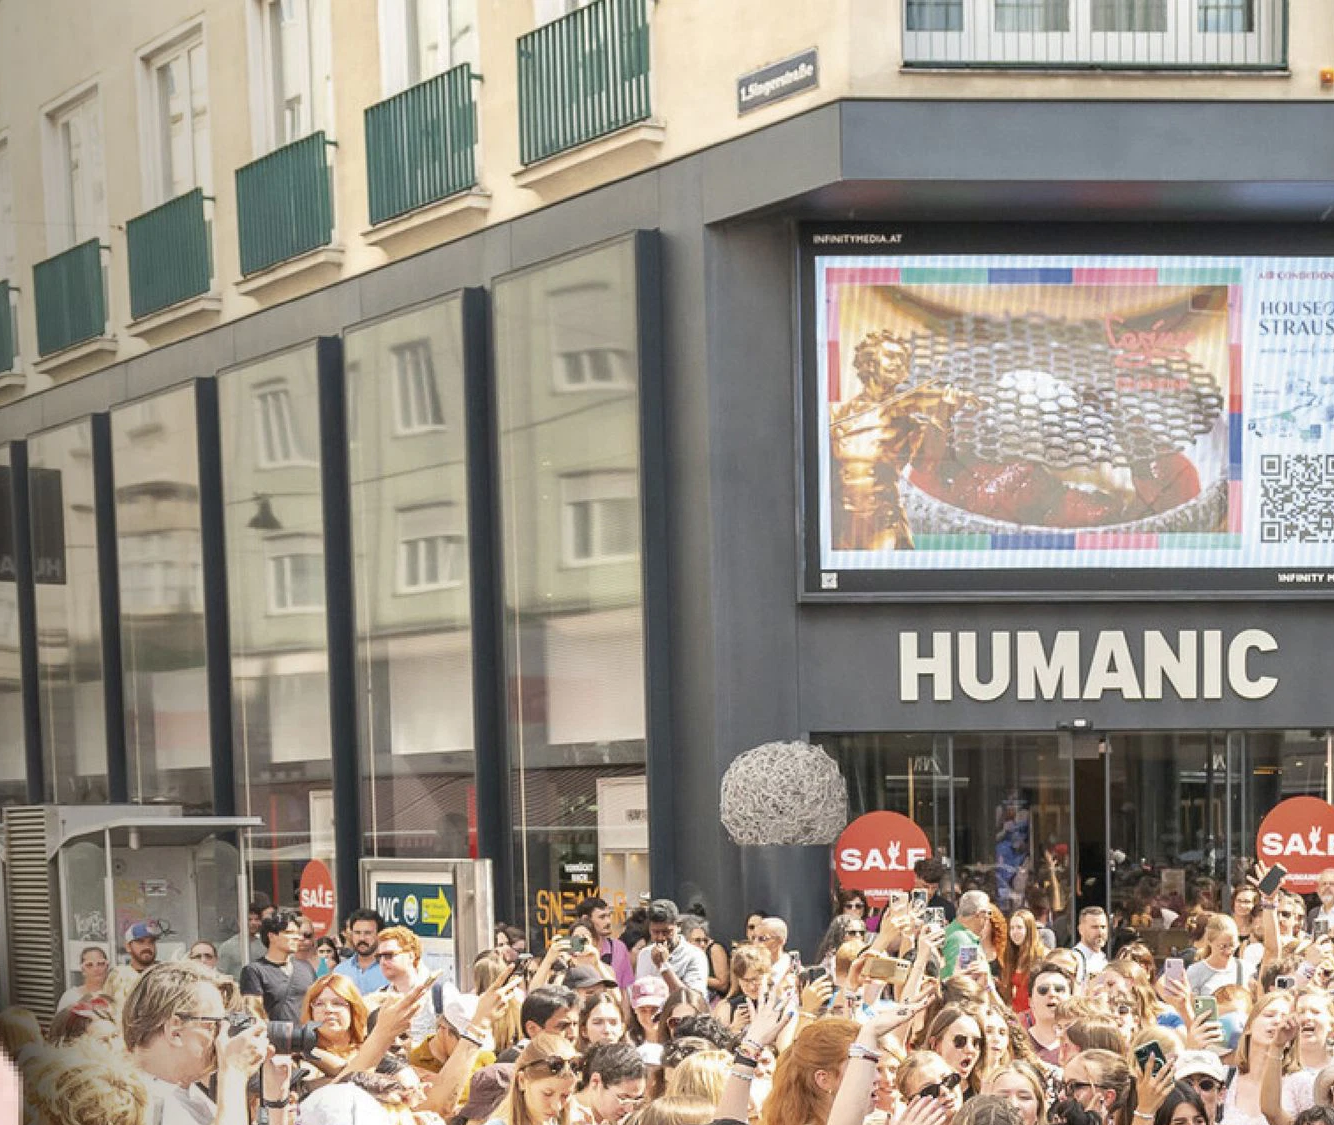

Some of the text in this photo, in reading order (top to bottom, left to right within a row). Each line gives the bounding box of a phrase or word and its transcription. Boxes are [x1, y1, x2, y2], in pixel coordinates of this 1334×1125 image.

[812, 233, 902, 245] INFINITYMEDIA.AT
[1277, 572, 1325, 583] INFINITY
[898, 628, 1279, 701] HUMANIC
[840, 840, 927, 872] SALE
[301, 885, 334, 909] SALE
[378, 897, 400, 923] WC
